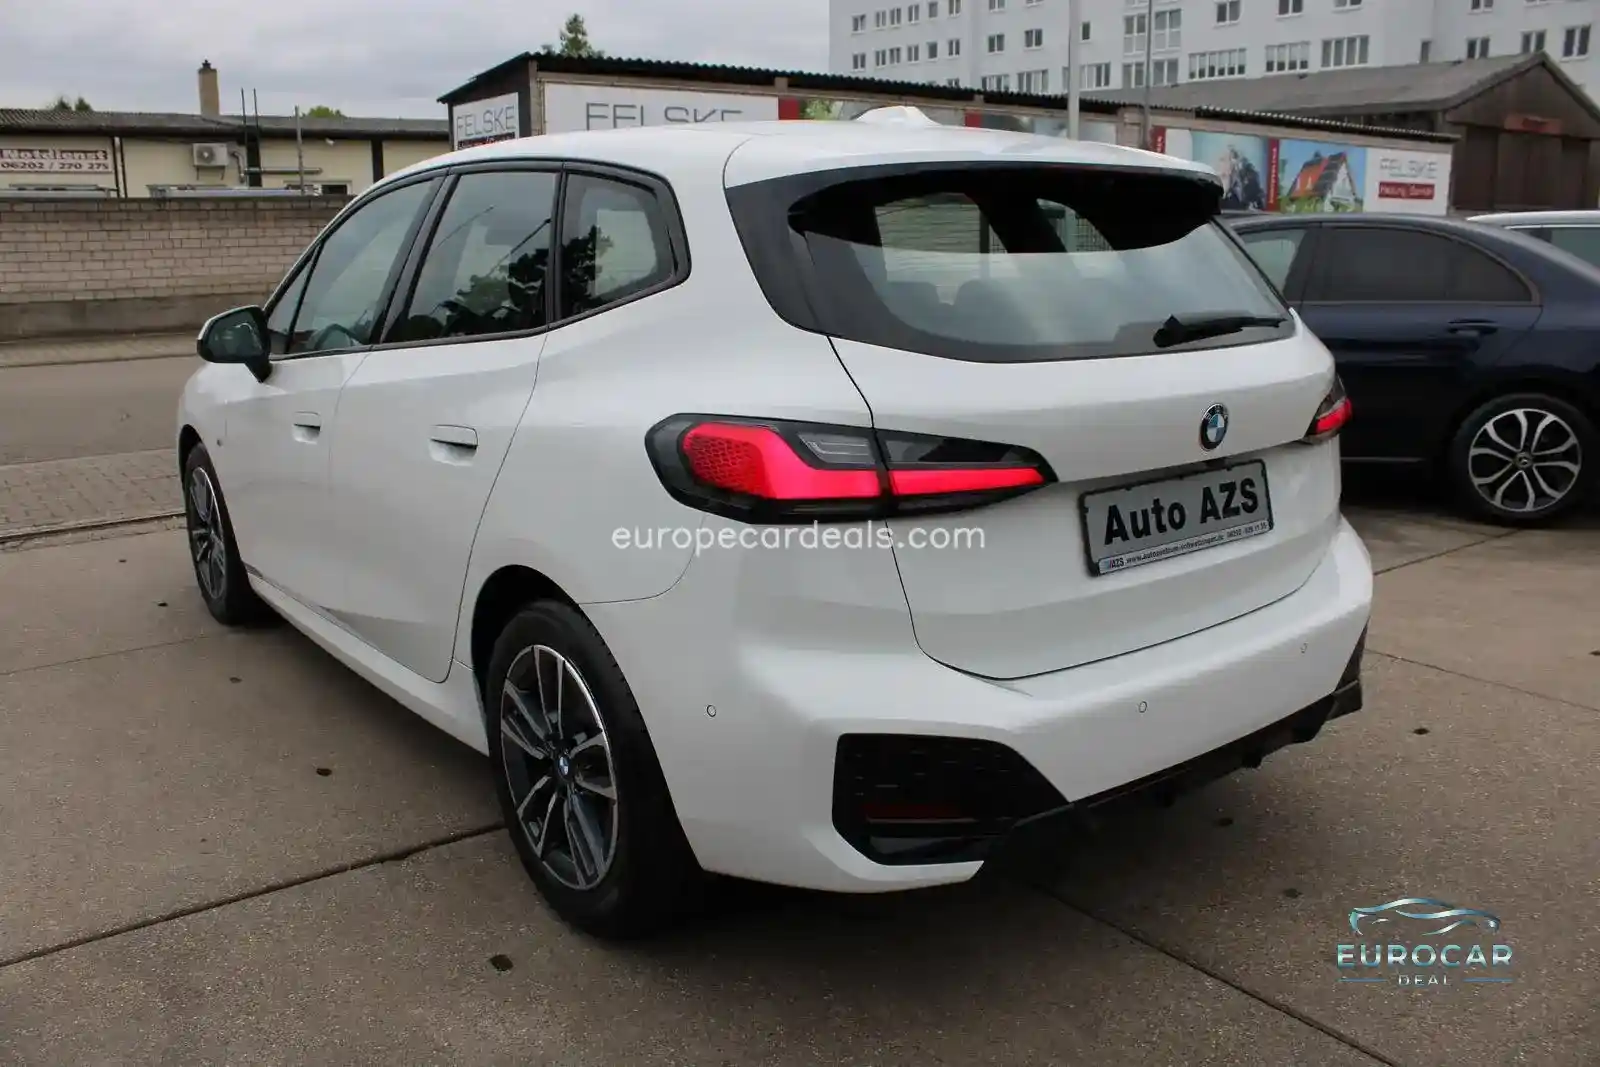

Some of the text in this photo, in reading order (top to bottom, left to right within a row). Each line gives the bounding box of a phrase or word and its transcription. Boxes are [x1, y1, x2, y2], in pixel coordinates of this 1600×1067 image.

[457, 105, 516, 138] FELSKE
[3, 149, 108, 160] Notdienst
[1104, 478, 1259, 546] Auto AZS
